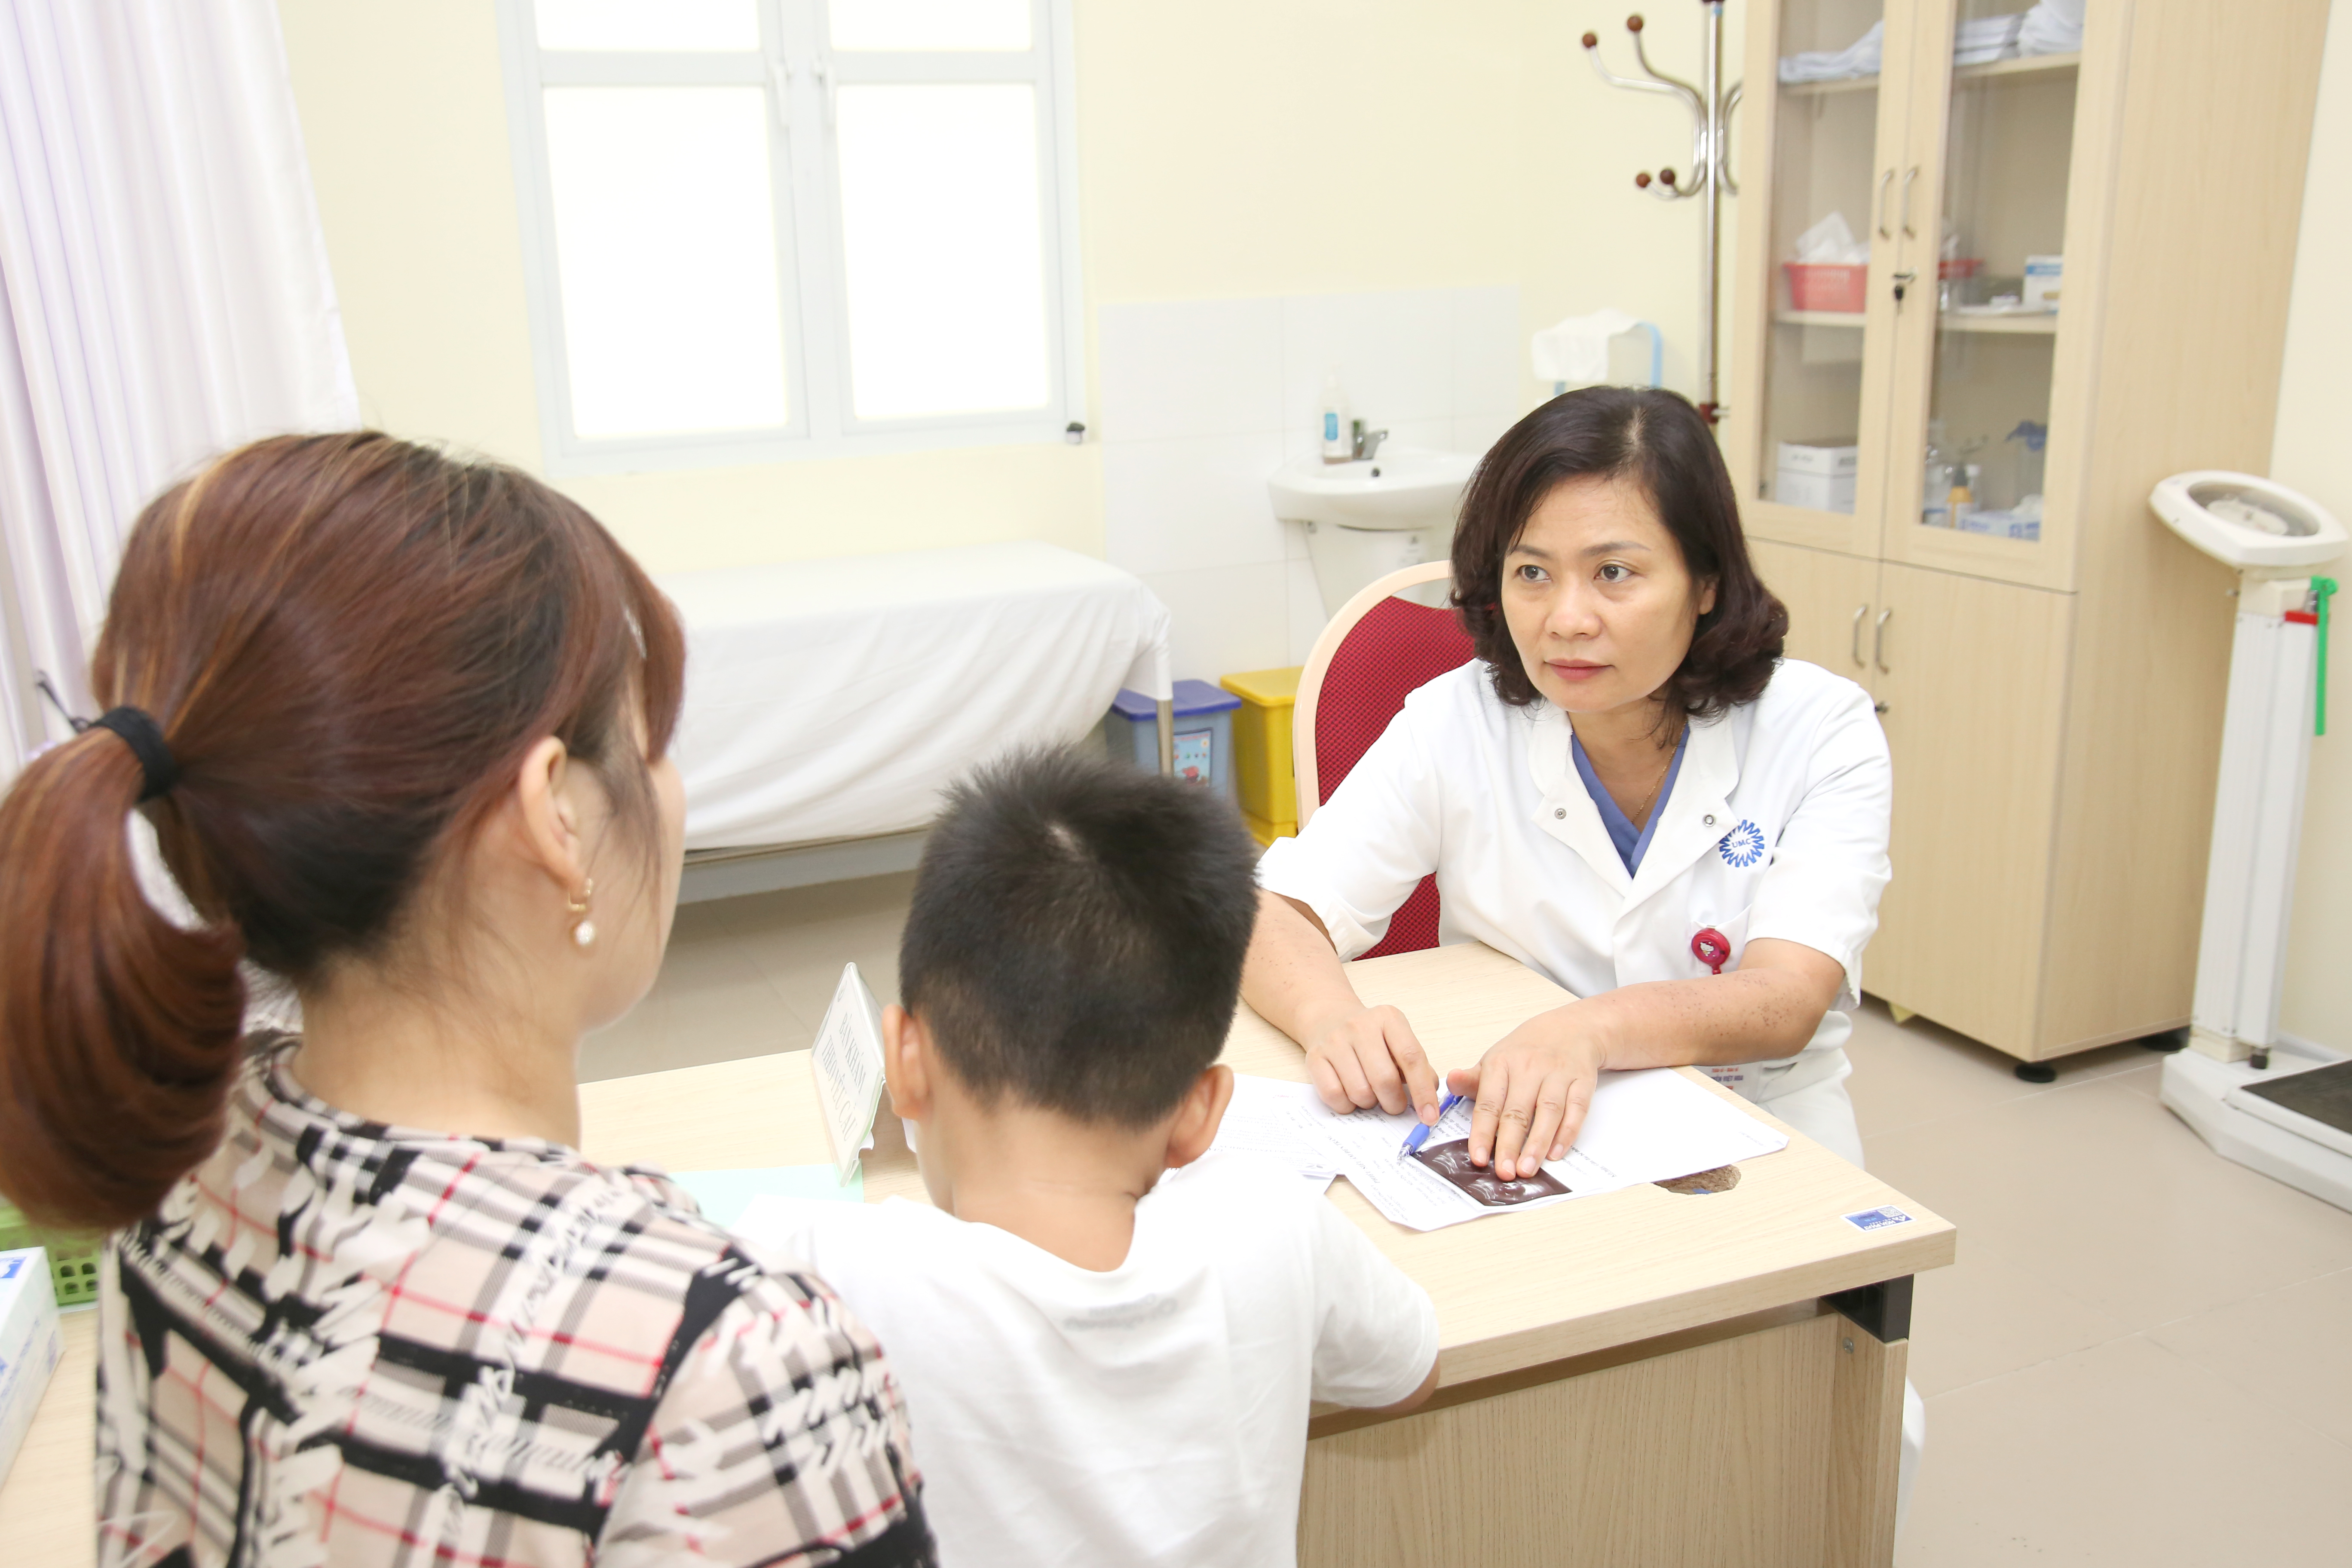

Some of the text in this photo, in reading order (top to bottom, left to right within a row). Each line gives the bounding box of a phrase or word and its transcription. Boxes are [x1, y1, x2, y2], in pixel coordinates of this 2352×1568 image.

[1732, 839, 1752, 848] UMC
[822, 1035, 837, 1081] THEO
[831, 1068, 847, 1110] YÊU
[845, 1037, 866, 1095] KHÁM
